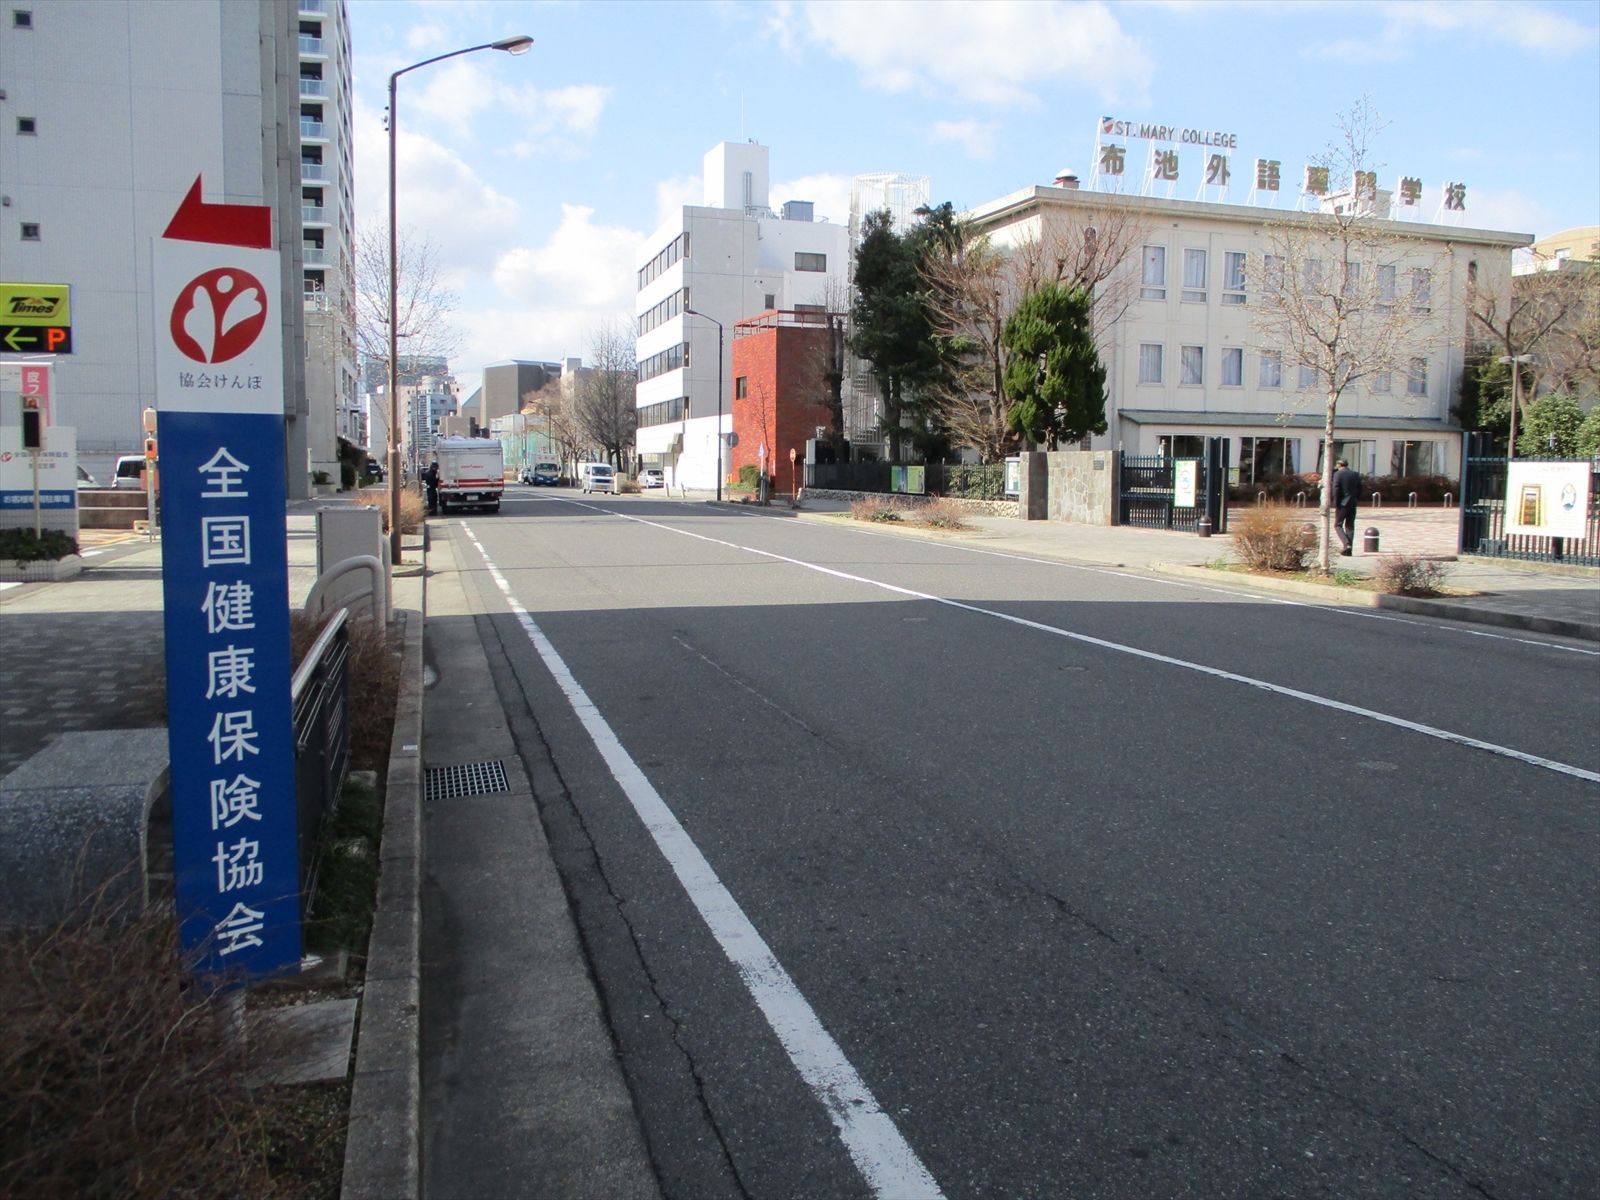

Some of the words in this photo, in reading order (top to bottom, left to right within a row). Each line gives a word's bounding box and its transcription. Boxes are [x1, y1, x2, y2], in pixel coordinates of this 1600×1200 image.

[1115, 120, 1136, 137] ST.
[1140, 123, 1175, 141] MARY
[1182, 128, 1237, 148] COLLEGE
[9, 296, 56, 313] Times
[47, 328, 66, 351] P
[198, 446, 265, 956] 全国健康保険協会
